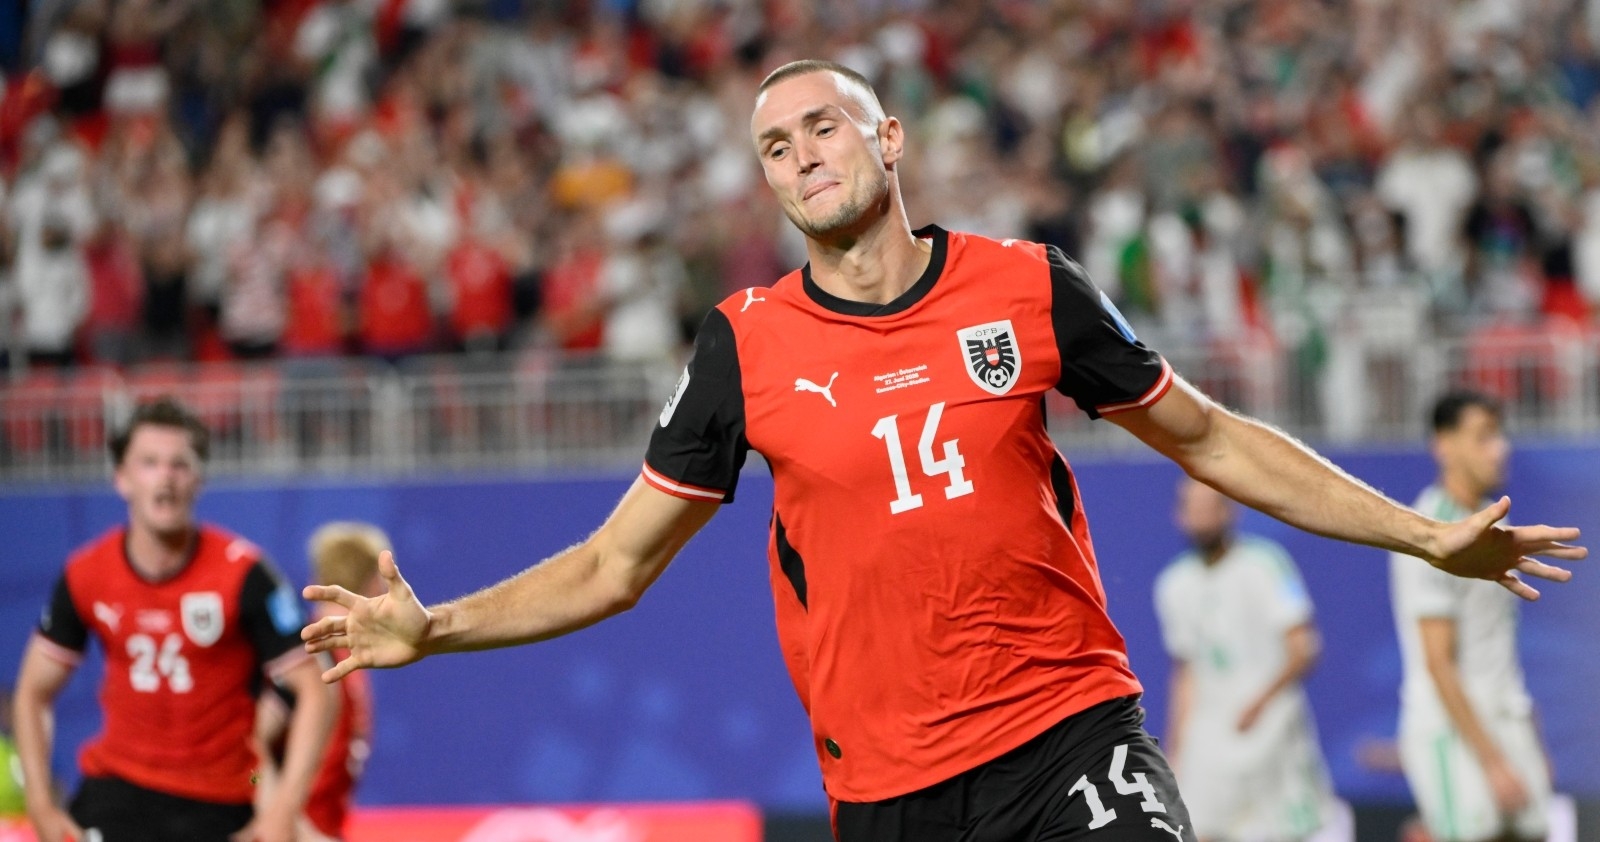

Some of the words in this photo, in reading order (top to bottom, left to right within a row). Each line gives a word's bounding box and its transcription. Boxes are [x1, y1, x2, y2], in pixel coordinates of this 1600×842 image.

[870, 401, 975, 515] 14
[125, 633, 195, 694] 24
[1067, 744, 1167, 830] 14
